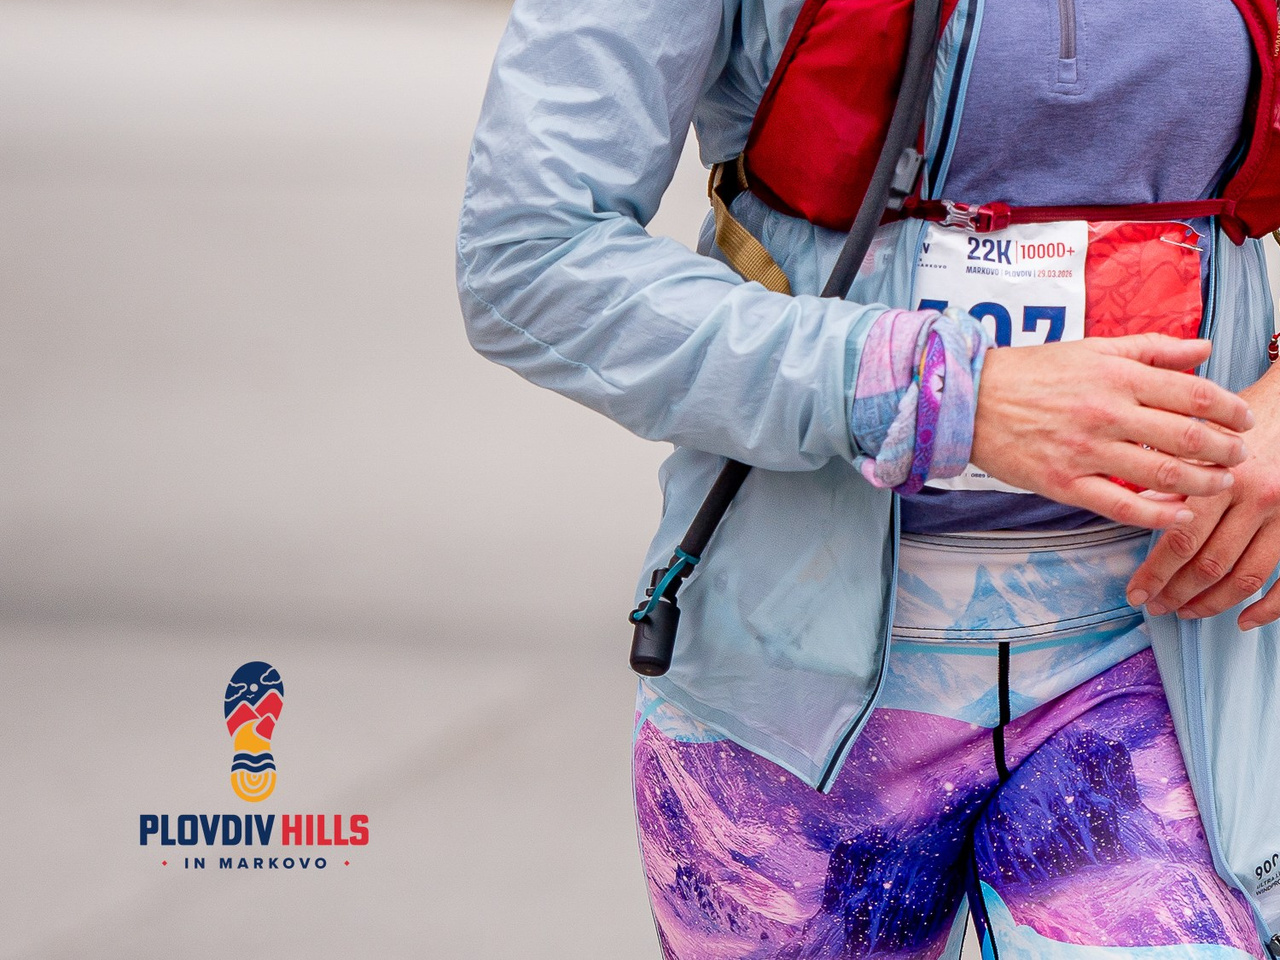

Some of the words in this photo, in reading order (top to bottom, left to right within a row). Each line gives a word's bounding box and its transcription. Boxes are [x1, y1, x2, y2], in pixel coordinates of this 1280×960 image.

[967, 236, 1012, 265] 22K
[1020, 242, 1076, 260] 1000D+
[965, 266, 1000, 276] MARKOVO
[1004, 269, 1032, 278] PLOVDIV
[1037, 269, 1073, 278] 29.03.2026
